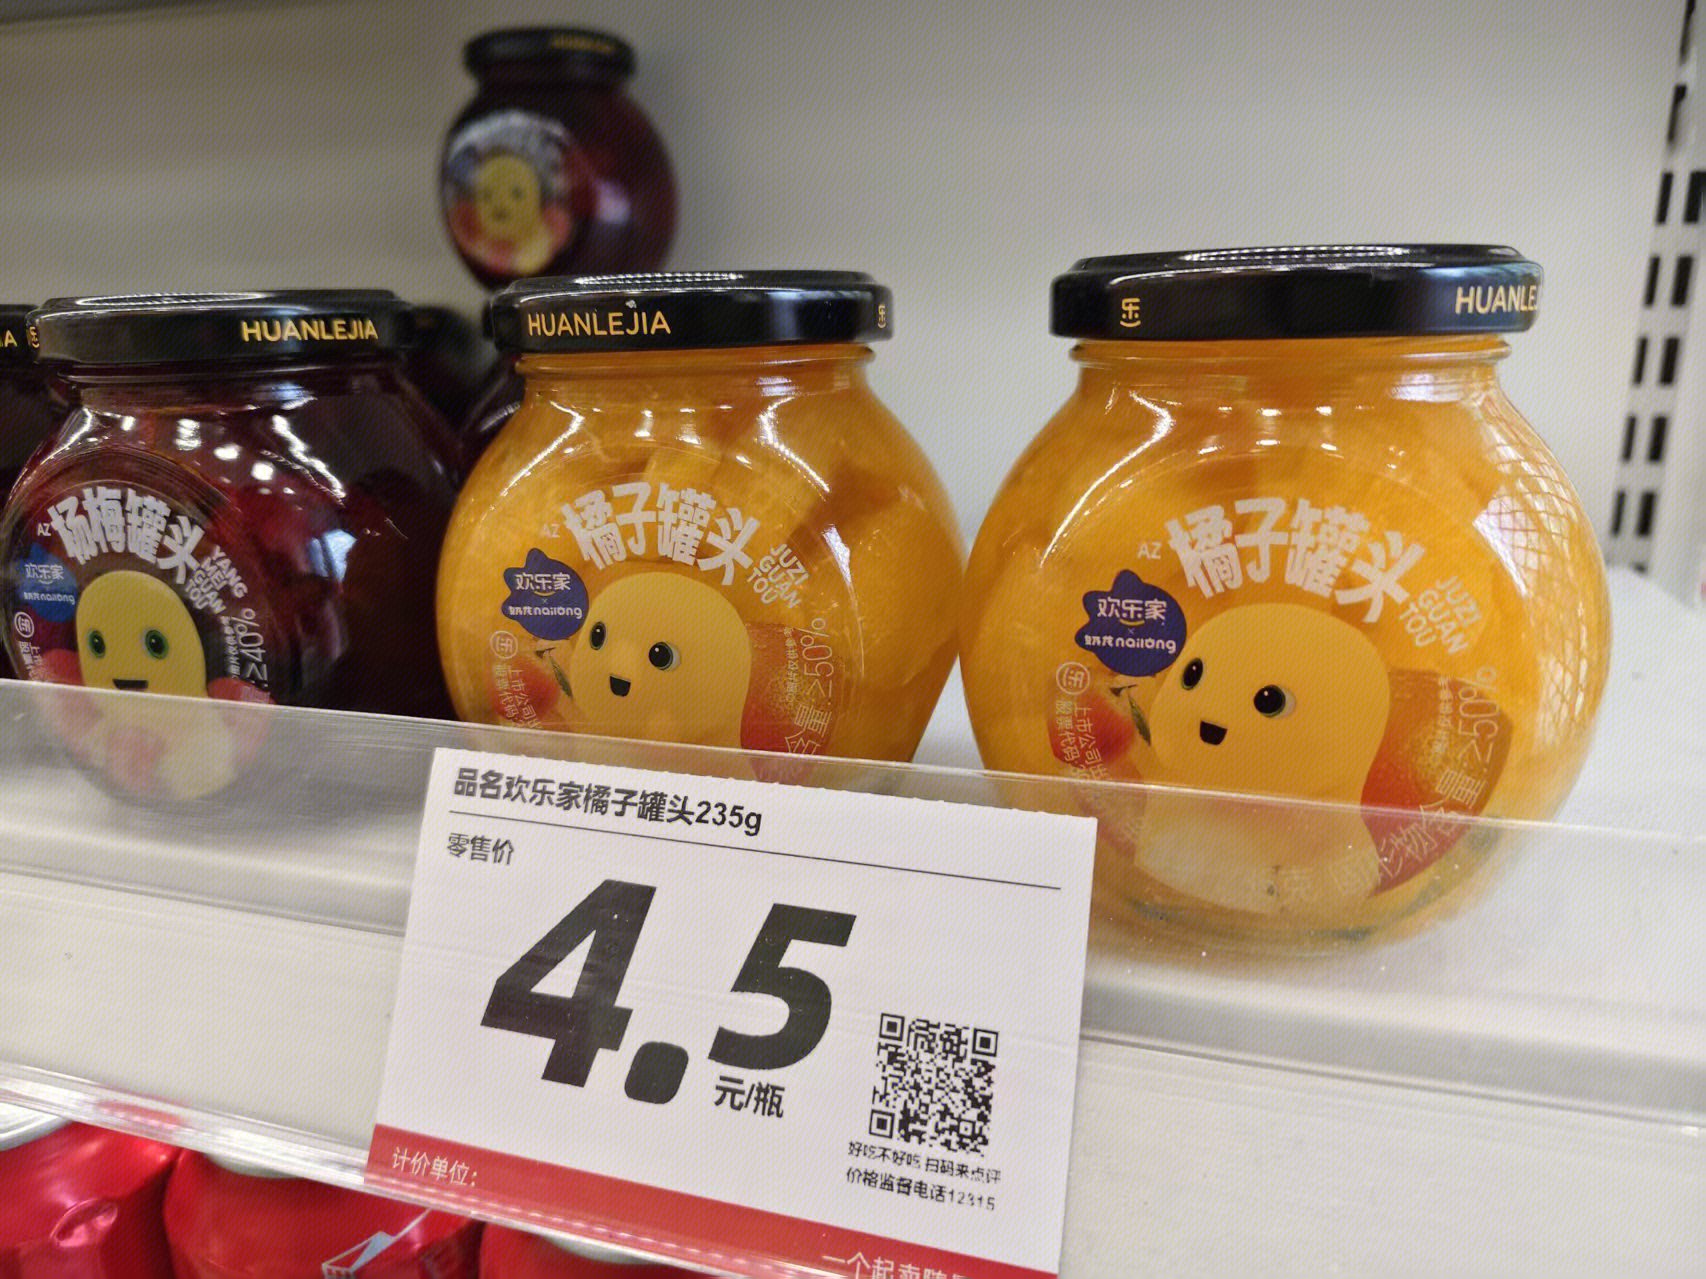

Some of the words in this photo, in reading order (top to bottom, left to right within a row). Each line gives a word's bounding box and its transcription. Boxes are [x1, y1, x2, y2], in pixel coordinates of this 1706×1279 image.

[1455, 285, 1538, 314] HUANLE
[241, 318, 378, 342] HUANLEJIA
[528, 311, 671, 337] HUANLEJIA
[37, 523, 51, 536] AZ
[47, 486, 205, 585] 杨梅罐头
[561, 481, 760, 586] 橘子罐头
[1138, 543, 1161, 559] AZ
[24, 564, 65, 581] 欢乐家
[201, 557, 228, 591] MEI
[213, 545, 248, 598] YANG
[515, 572, 571, 591] 欢乐家
[770, 543, 809, 586] JUZI
[1164, 496, 1425, 624] 橘子罐头
[185, 578, 208, 610] TOU
[193, 569, 227, 614] GUAN
[747, 567, 778, 605] TOU
[759, 556, 801, 608] GUAN
[1435, 575, 1483, 627] JUZI
[1096, 597, 1167, 620] 欢乐家
[1398, 602, 1437, 647] TOU
[1418, 589, 1468, 654] GUAN
[453, 767, 763, 837] 品名欢乐家橘子罐头235g
[447, 832, 515, 865] 零售价
[480, 878, 857, 1104] 4.5
[714, 1075, 784, 1118] 元/瓶
[392, 1146, 477, 1187] 计价单位:
[846, 1167, 996, 1211] 价格监督电话12315
